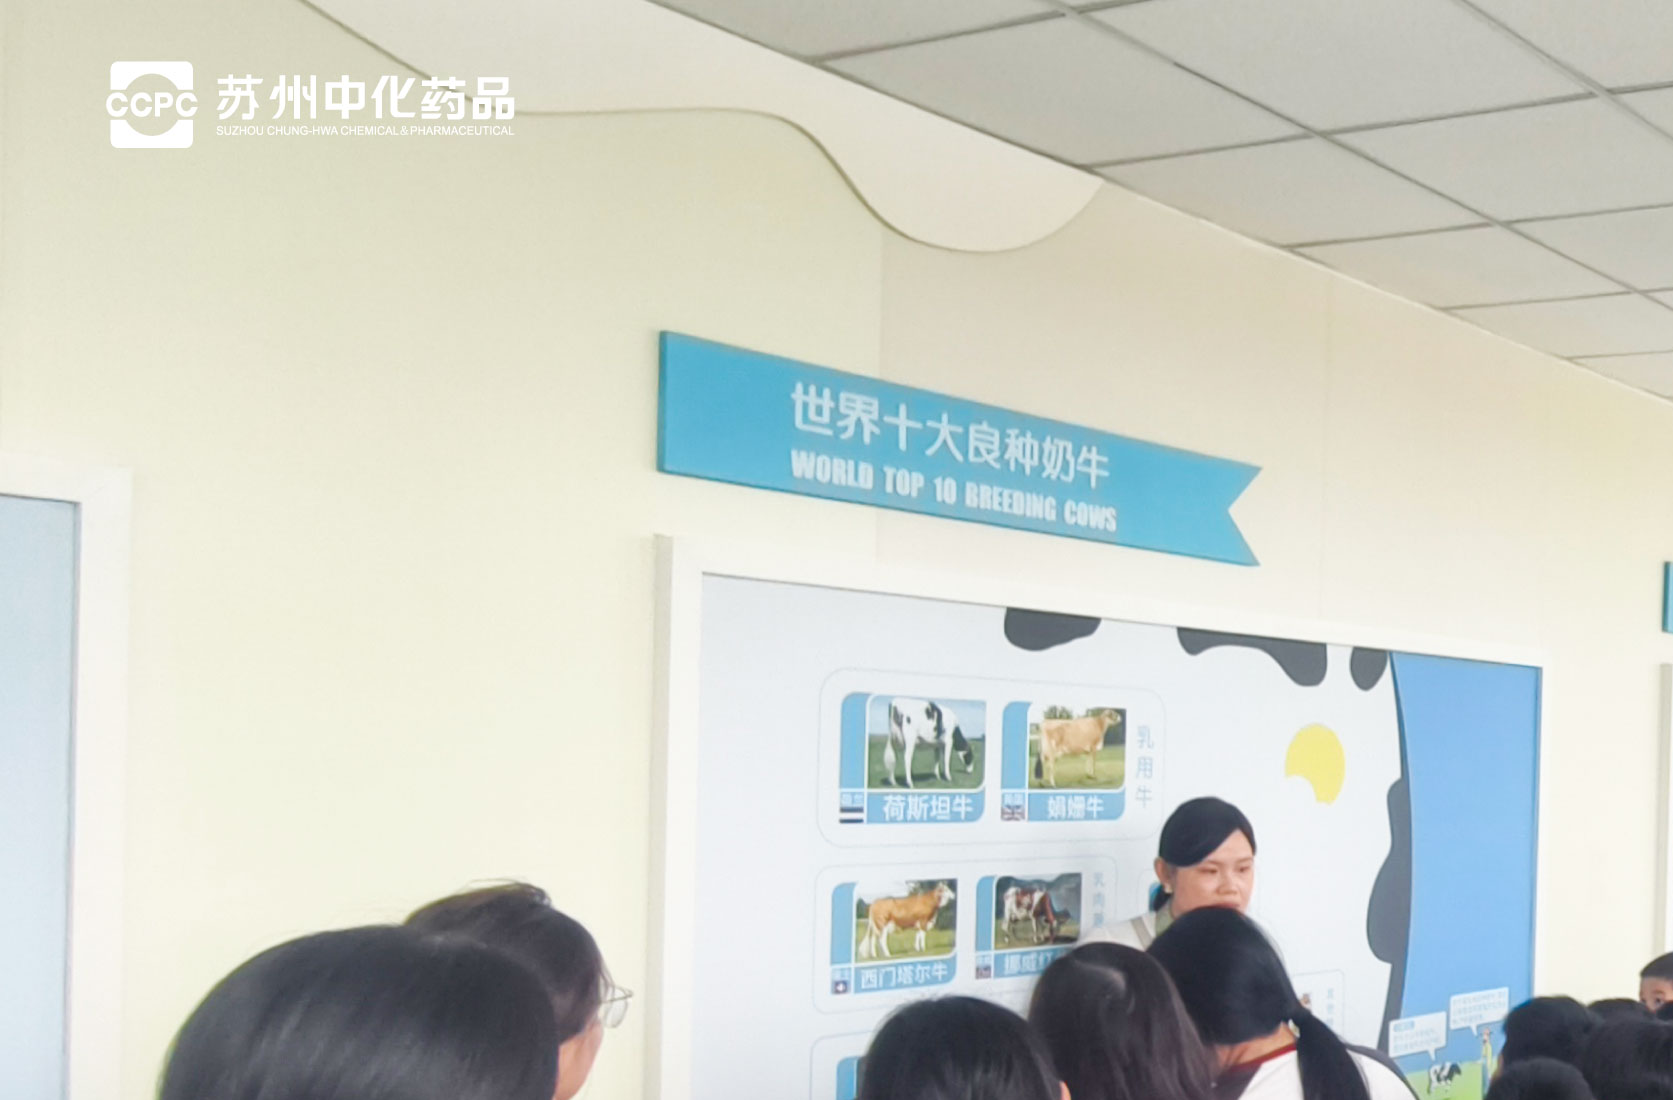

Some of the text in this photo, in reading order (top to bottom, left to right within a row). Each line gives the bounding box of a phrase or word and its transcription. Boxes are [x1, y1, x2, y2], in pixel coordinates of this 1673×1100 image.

[790, 381, 1110, 489] 世界十大良种奶牛
[791, 449, 1117, 532] WORLD TOP 10 BREEDING COWS
[1136, 725, 1154, 808] 乳用牛
[883, 794, 973, 821] 荷斯坦牛
[1048, 795, 1104, 819] 娟姗牛
[861, 961, 948, 990] 西门塔尔牛
